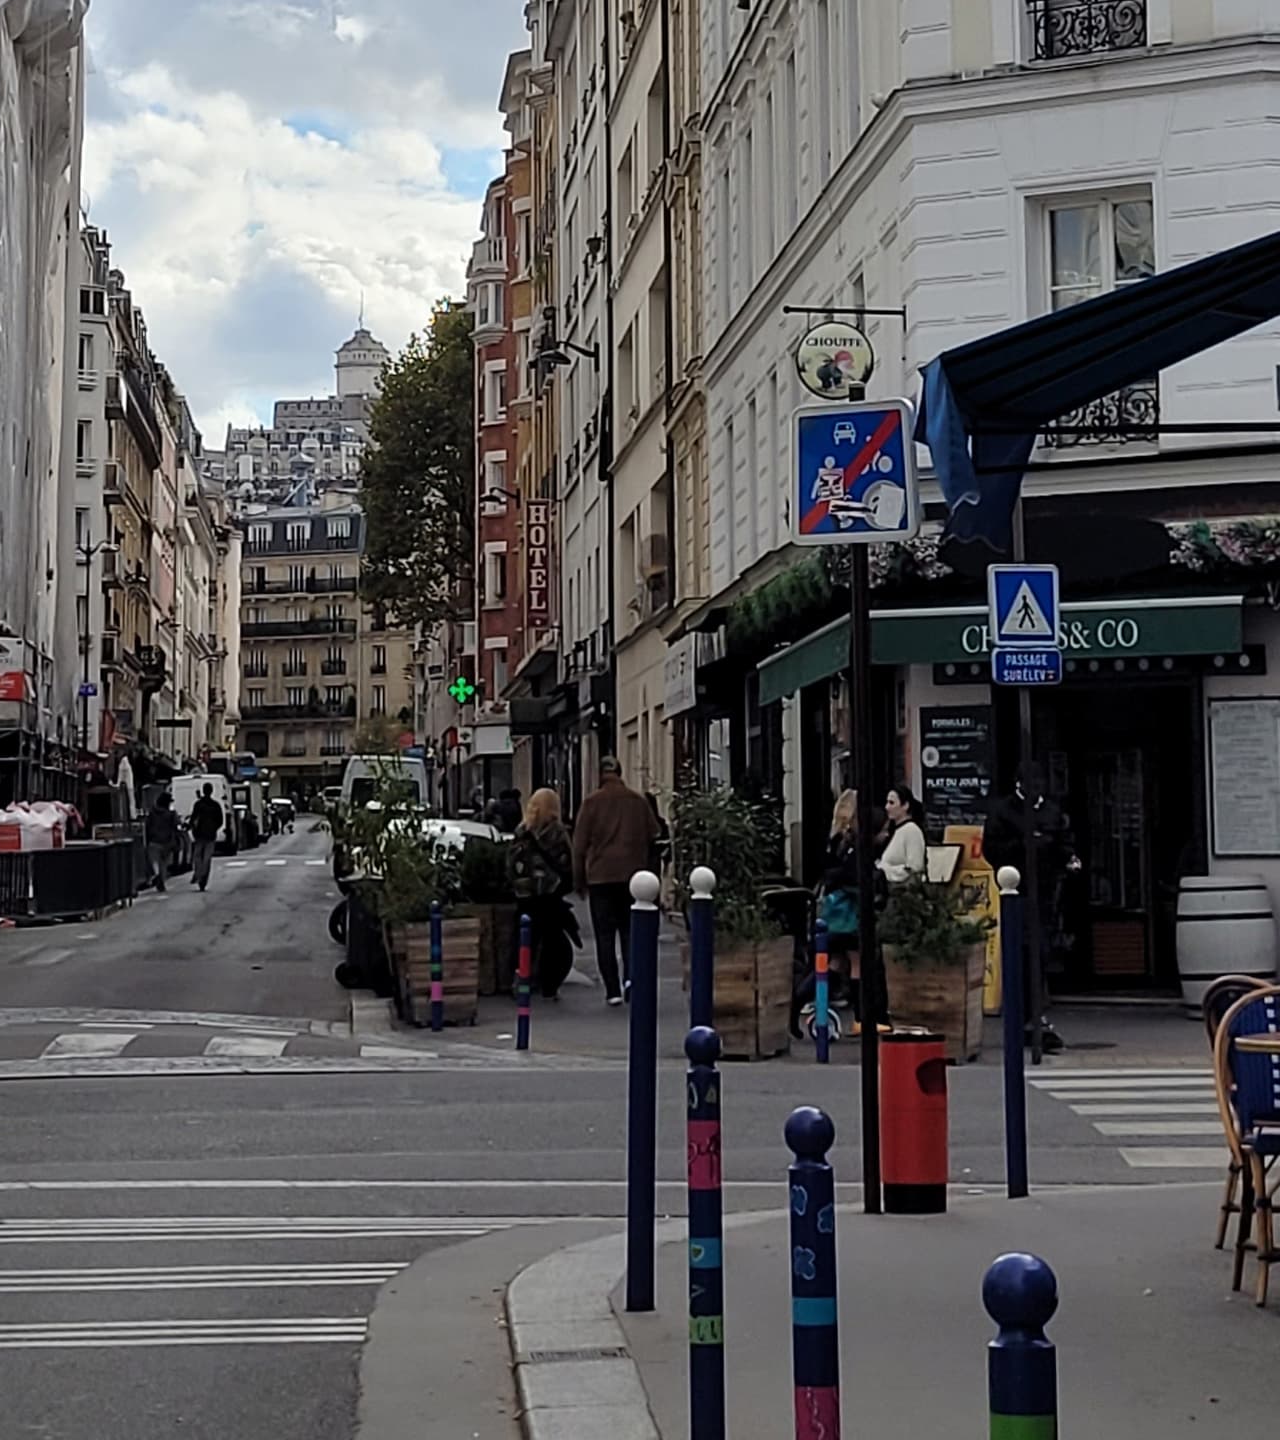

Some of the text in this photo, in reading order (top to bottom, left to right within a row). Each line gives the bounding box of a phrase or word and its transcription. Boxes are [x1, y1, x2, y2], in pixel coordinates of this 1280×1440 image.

[806, 337, 864, 348] CHOUFFE
[528, 504, 547, 610] HOTEL
[1097, 617, 1139, 649] CO
[1005, 653, 1048, 666] PASSAGE
[1003, 667, 1055, 682] SURÉLEV
